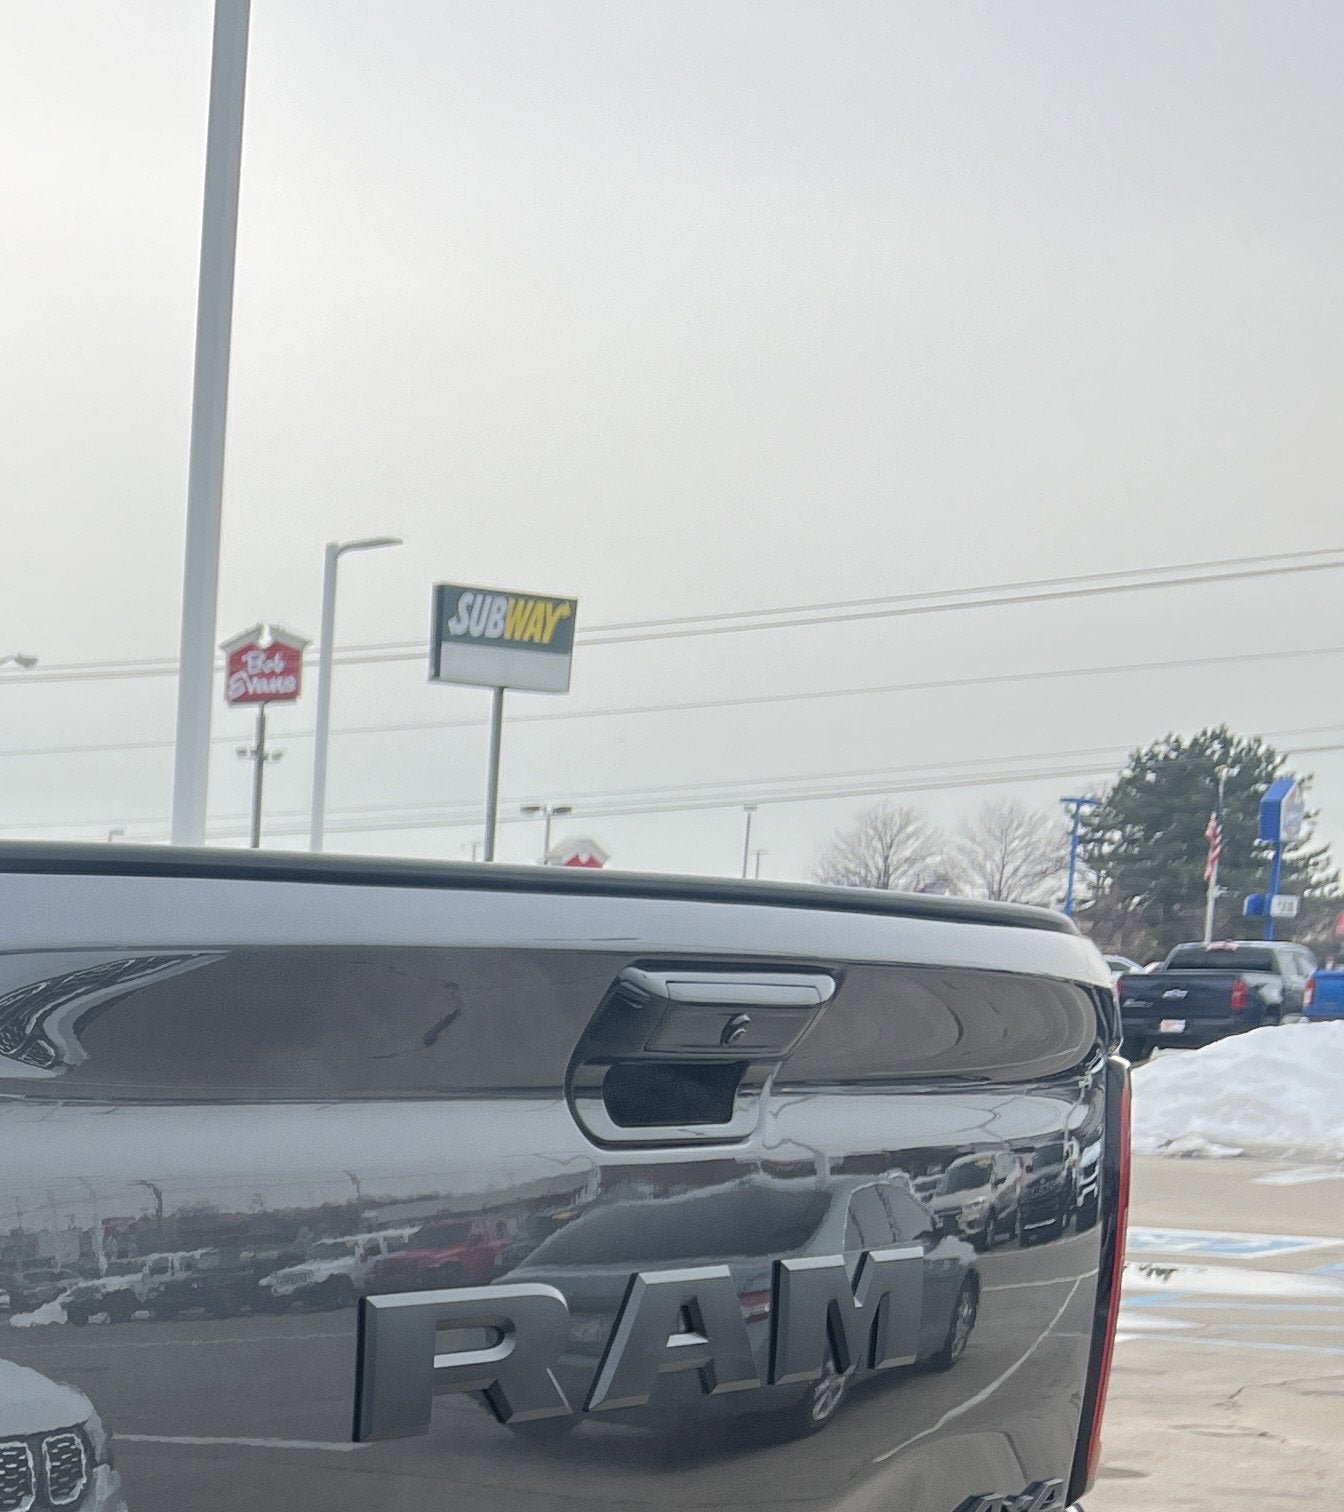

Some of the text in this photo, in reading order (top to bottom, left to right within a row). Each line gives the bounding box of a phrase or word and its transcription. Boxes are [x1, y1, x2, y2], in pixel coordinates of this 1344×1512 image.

[447, 591, 572, 645] SUBWAY
[241, 650, 285, 675] Bob
[227, 671, 297, 699] Evans
[353, 1247, 924, 1443] RAM
